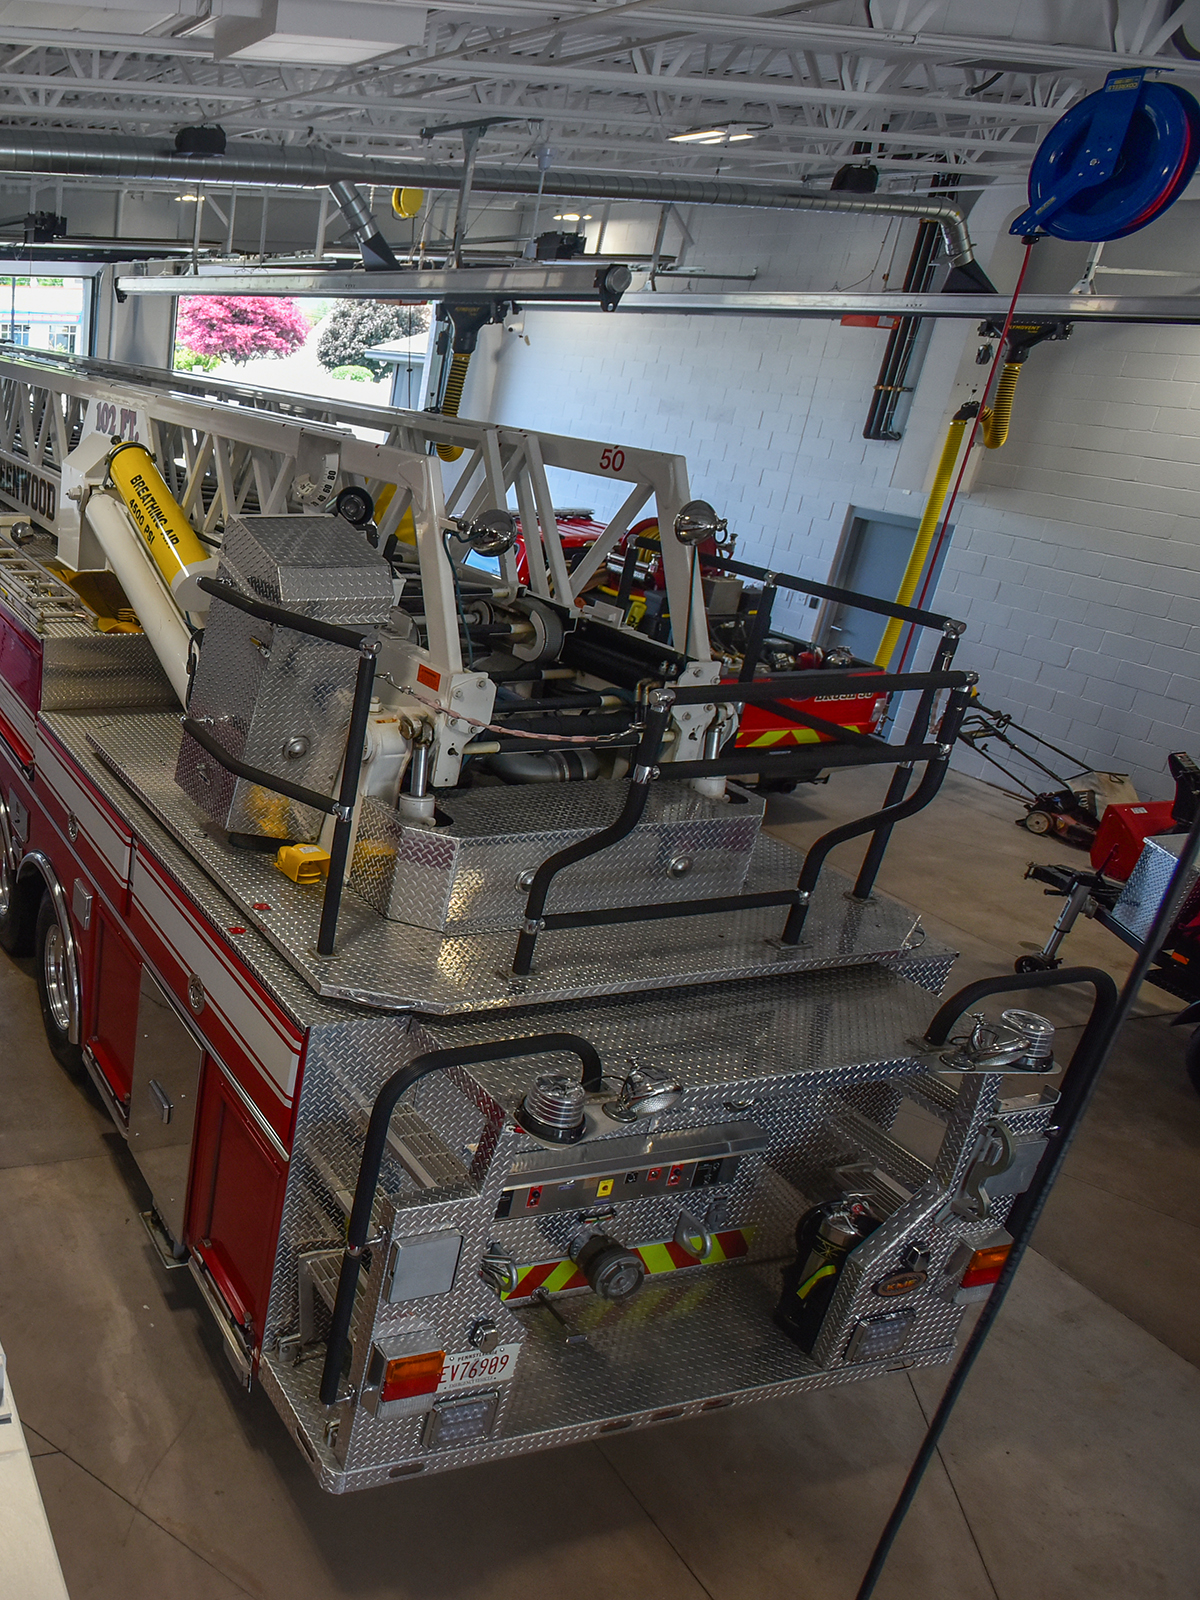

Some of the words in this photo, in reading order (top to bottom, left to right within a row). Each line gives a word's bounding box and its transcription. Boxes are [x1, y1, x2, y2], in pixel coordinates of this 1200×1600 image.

[96, 402, 116, 434] 102
[120, 408, 140, 442] FT.
[323, 484, 332, 493] 60
[327, 470, 336, 480] 80
[129, 499, 145, 526] 4500
[143, 524, 155, 545] PSI
[130, 474, 168, 530] BREATHING
[160, 528, 180, 549] AIR
[439, 1354, 510, 1384] EV76909
